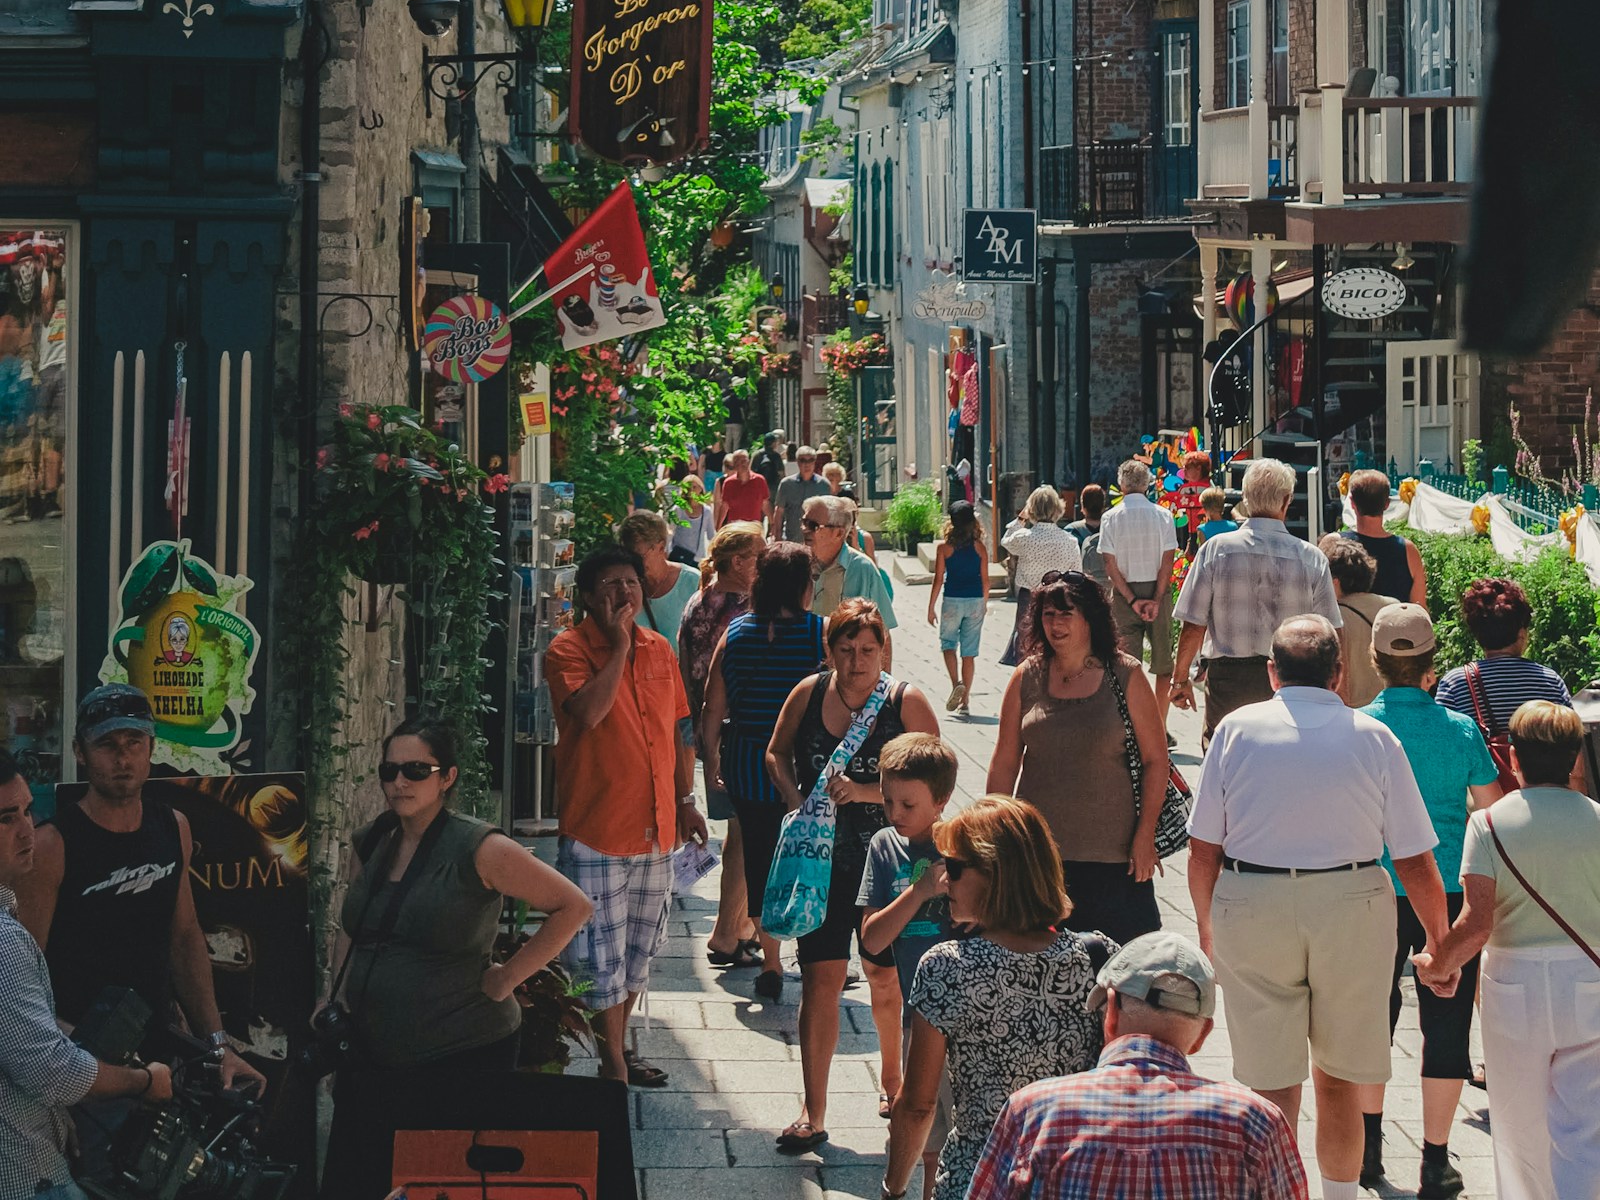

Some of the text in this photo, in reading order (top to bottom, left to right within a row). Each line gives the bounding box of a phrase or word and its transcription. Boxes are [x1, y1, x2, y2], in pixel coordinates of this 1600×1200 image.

[585, 3, 700, 72] Forgeron
[1340, 288, 1388, 299] BICO
[914, 301, 984, 321] Scrupules
[455, 314, 503, 341] Bon
[432, 332, 494, 367] Bons
[201, 609, 251, 641] L'ORIGINAL
[153, 671, 204, 687] LIMONADE
[153, 695, 204, 716] THELMA
